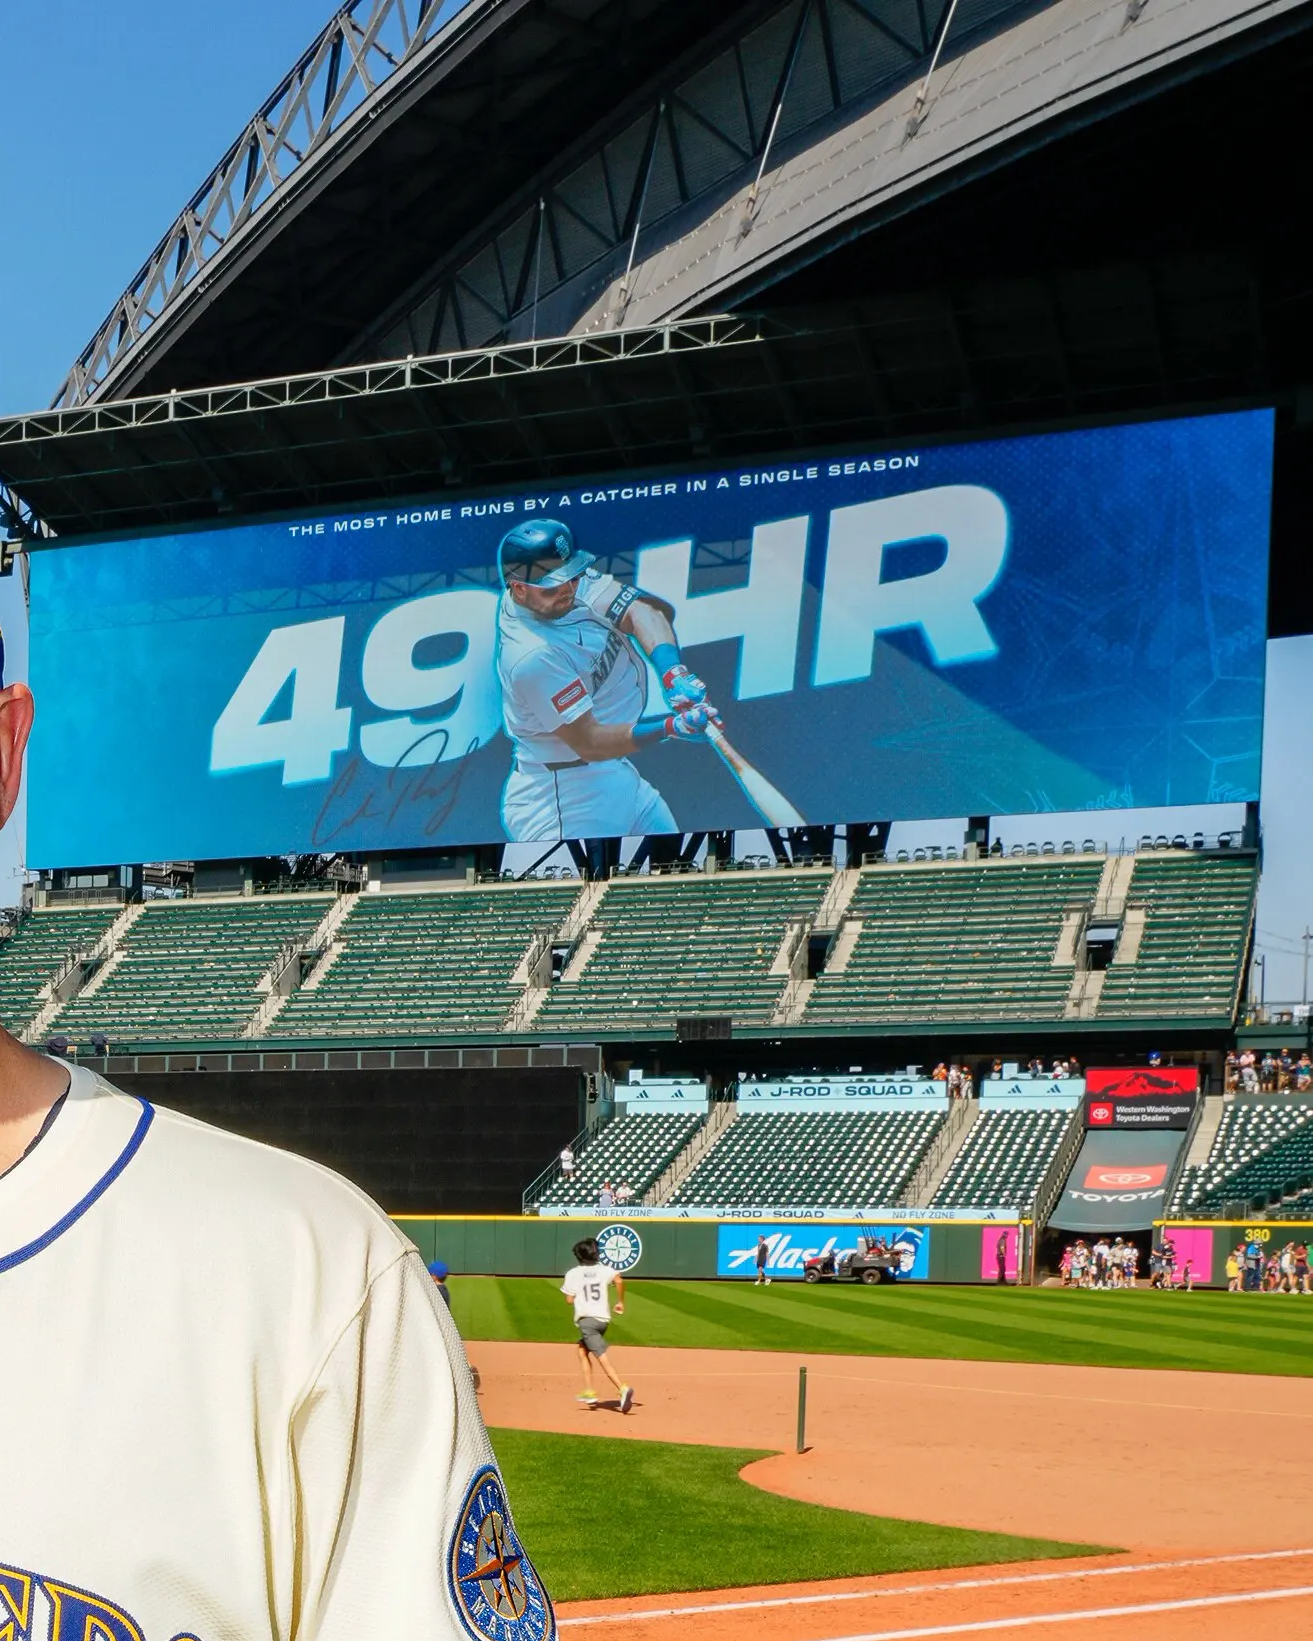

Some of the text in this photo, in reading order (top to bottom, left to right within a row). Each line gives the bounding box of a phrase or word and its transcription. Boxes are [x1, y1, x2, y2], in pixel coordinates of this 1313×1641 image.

[288, 456, 920, 537] THE MOST HOME RUNS BY A CATCHER IN A SINGLE SEASON
[209, 590, 503, 788] 49
[637, 483, 1011, 715] HR
[770, 1085, 913, 1097] J-ROD SQUAD
[1116, 1105, 1190, 1115] Western Washington
[1116, 1114, 1170, 1123] Toyota Dealers
[1067, 1189, 1167, 1203] TOYOTA
[595, 1209, 652, 1217] NO FLY ZONE
[716, 1210, 824, 1219] J-ROD SQUAD
[892, 1211, 955, 1220] NO FLY ZONE
[599, 1227, 637, 1244] SEATTLE
[1244, 1229, 1271, 1242] 380
[583, 1283, 601, 1302] 15
